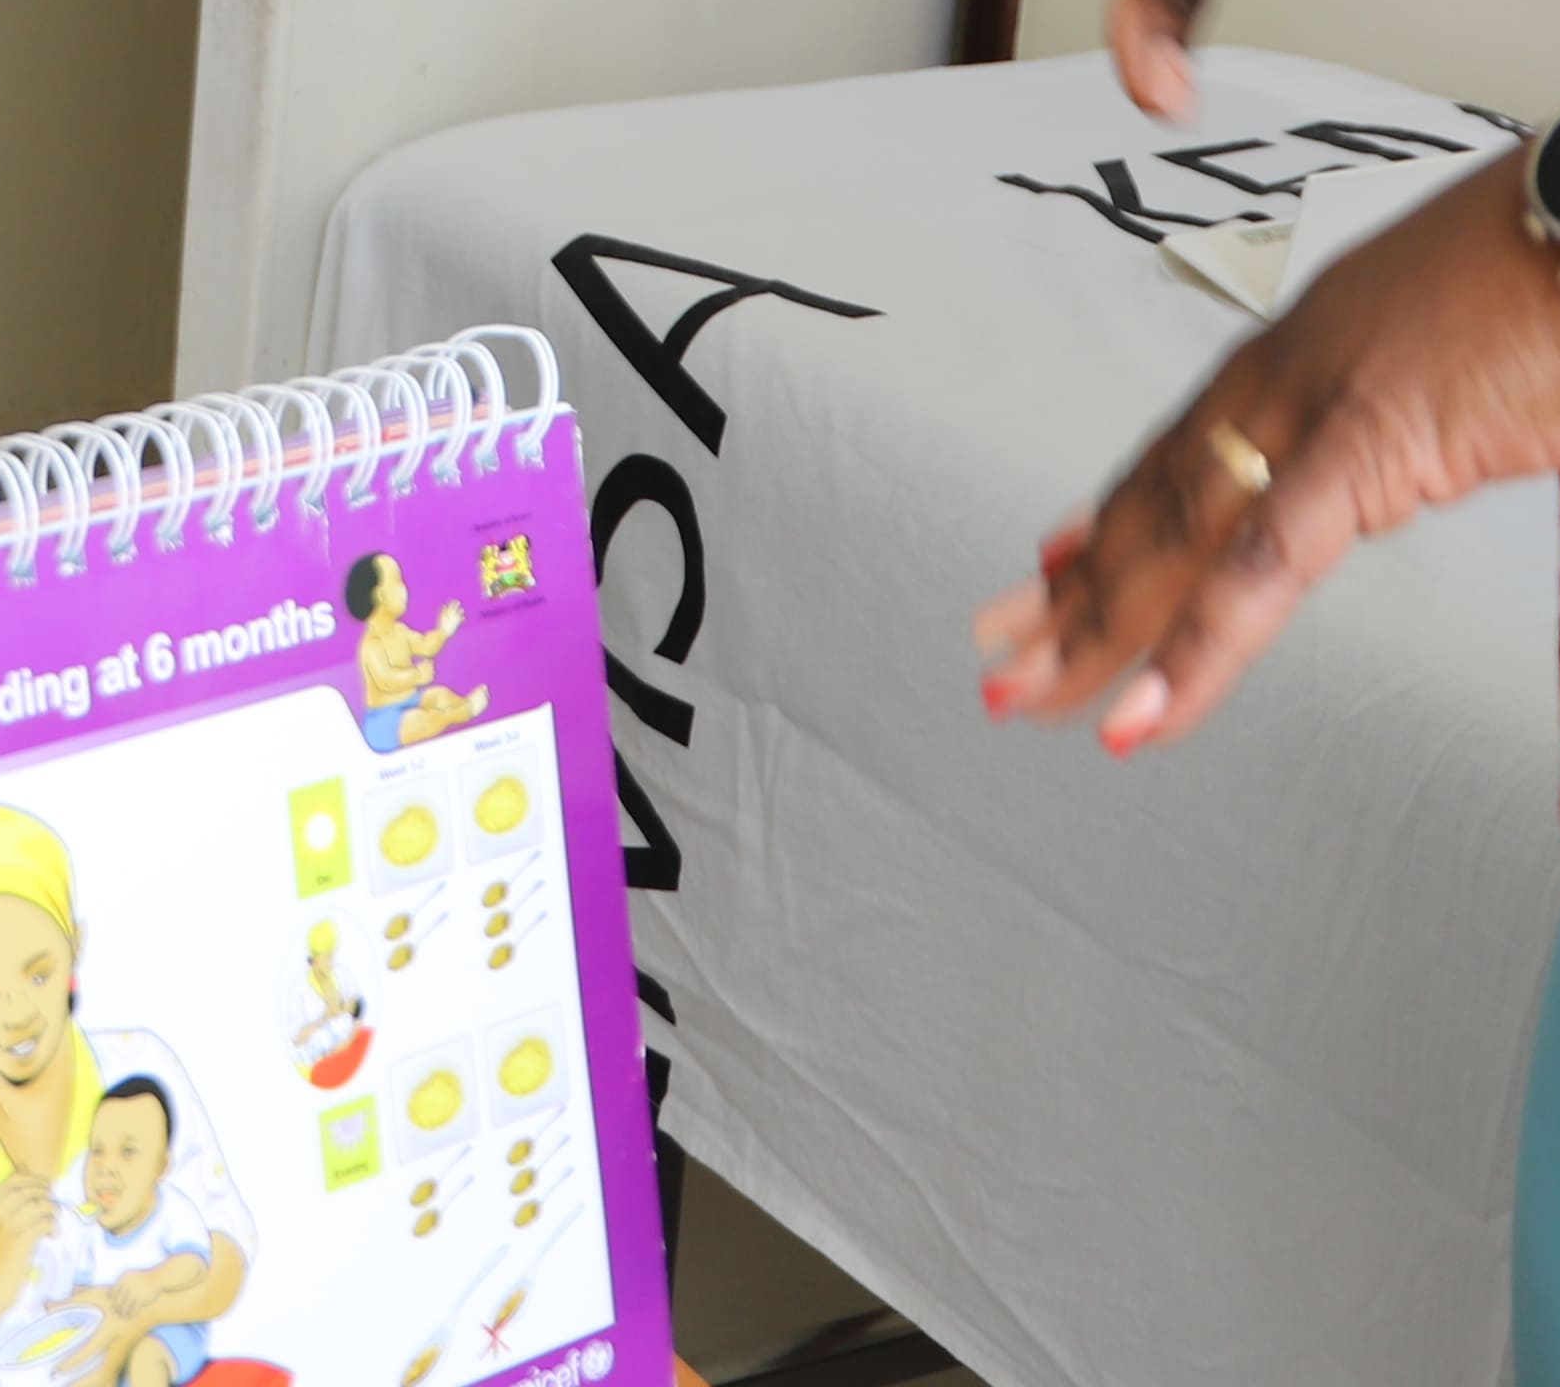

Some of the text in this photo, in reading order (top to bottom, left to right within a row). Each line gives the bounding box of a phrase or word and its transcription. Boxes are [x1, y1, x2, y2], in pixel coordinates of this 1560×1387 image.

[96, 642, 143, 697] at
[143, 631, 177, 684] 6
[181, 598, 337, 675] months
